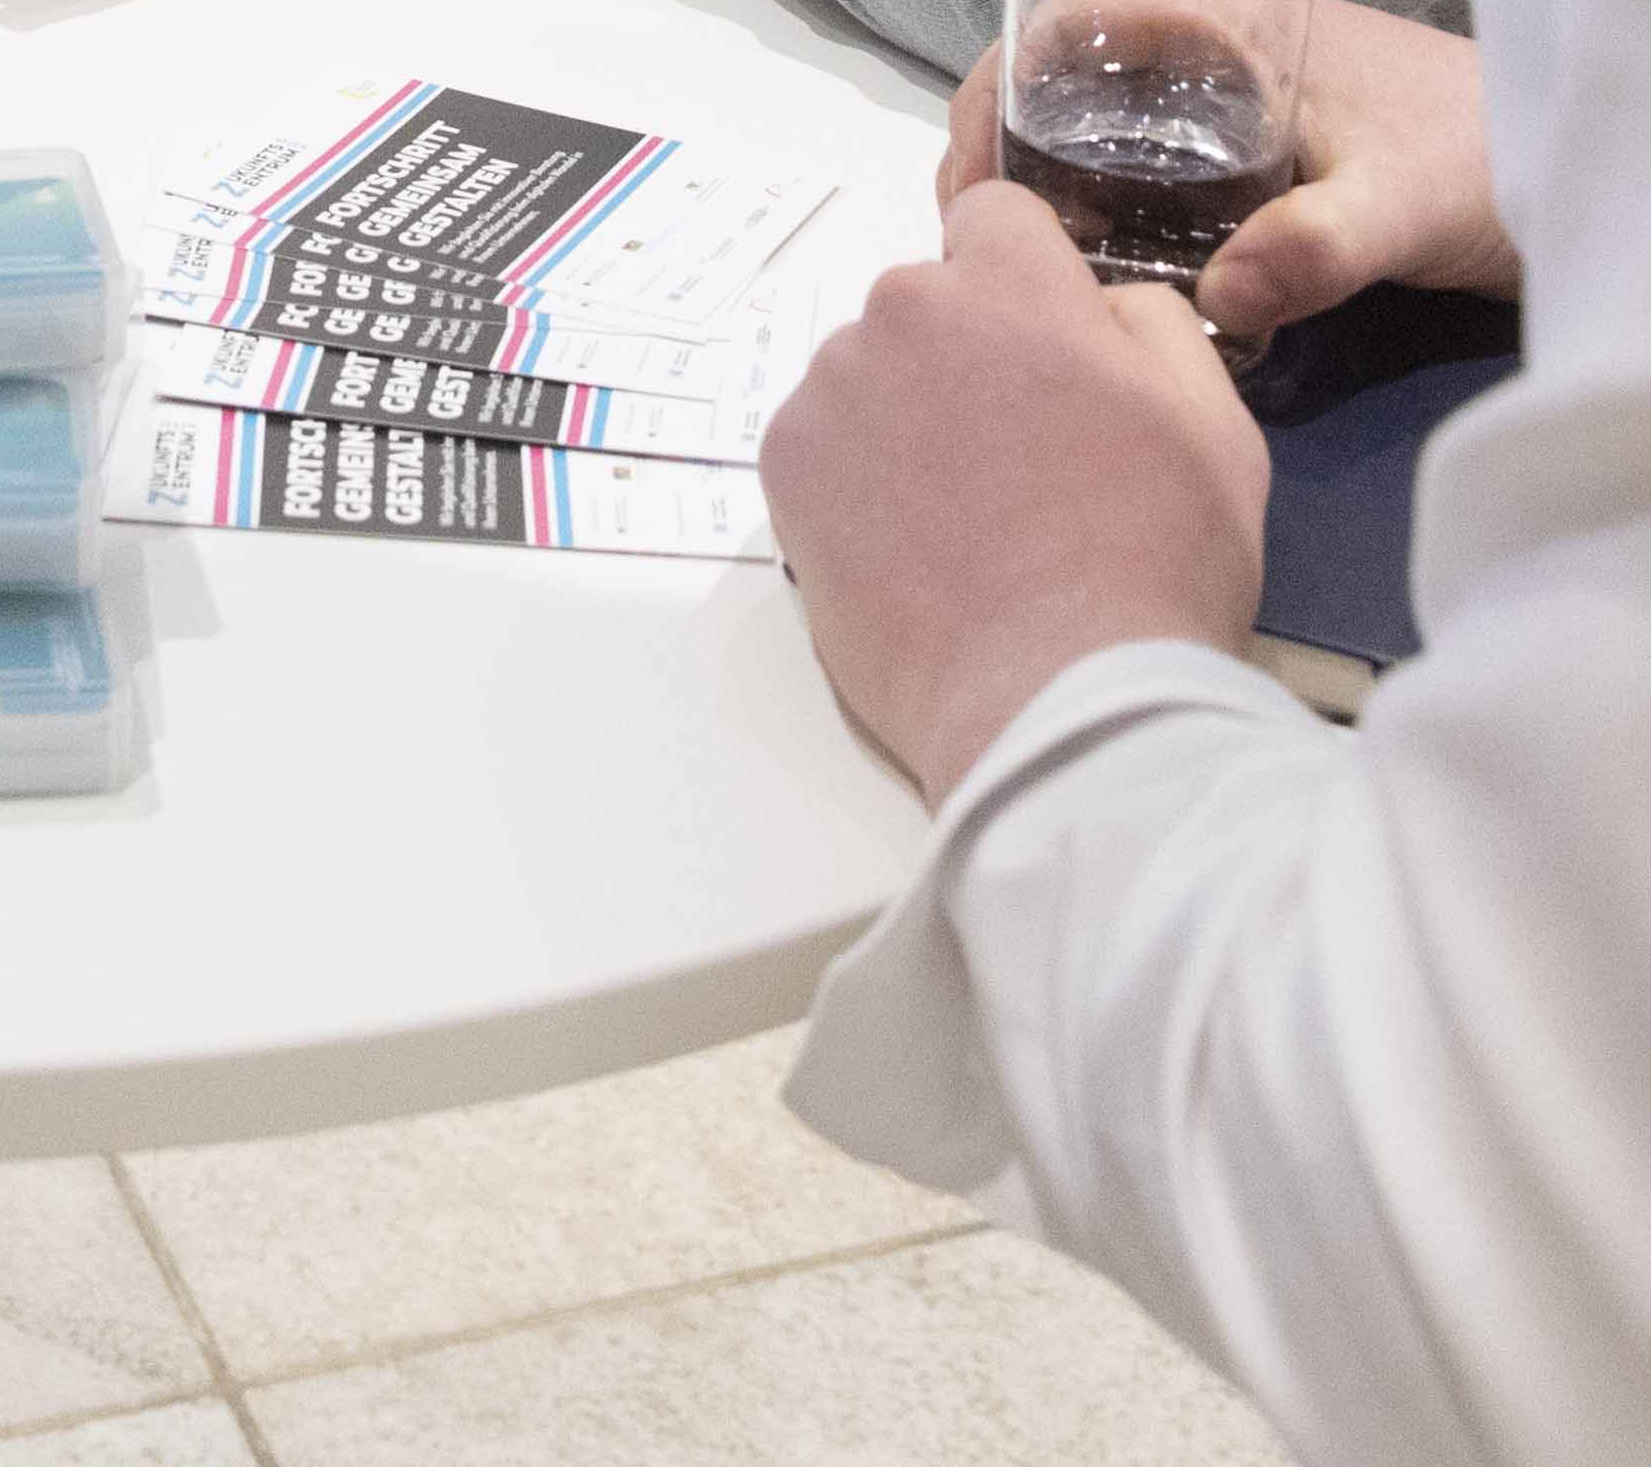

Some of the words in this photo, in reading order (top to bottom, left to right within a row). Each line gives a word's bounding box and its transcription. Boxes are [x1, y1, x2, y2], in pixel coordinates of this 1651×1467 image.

[315, 120, 461, 227] FORTSCHRITT
[358, 142, 488, 237] GEMEINSAM
[398, 157, 519, 247] GESTALTEN
